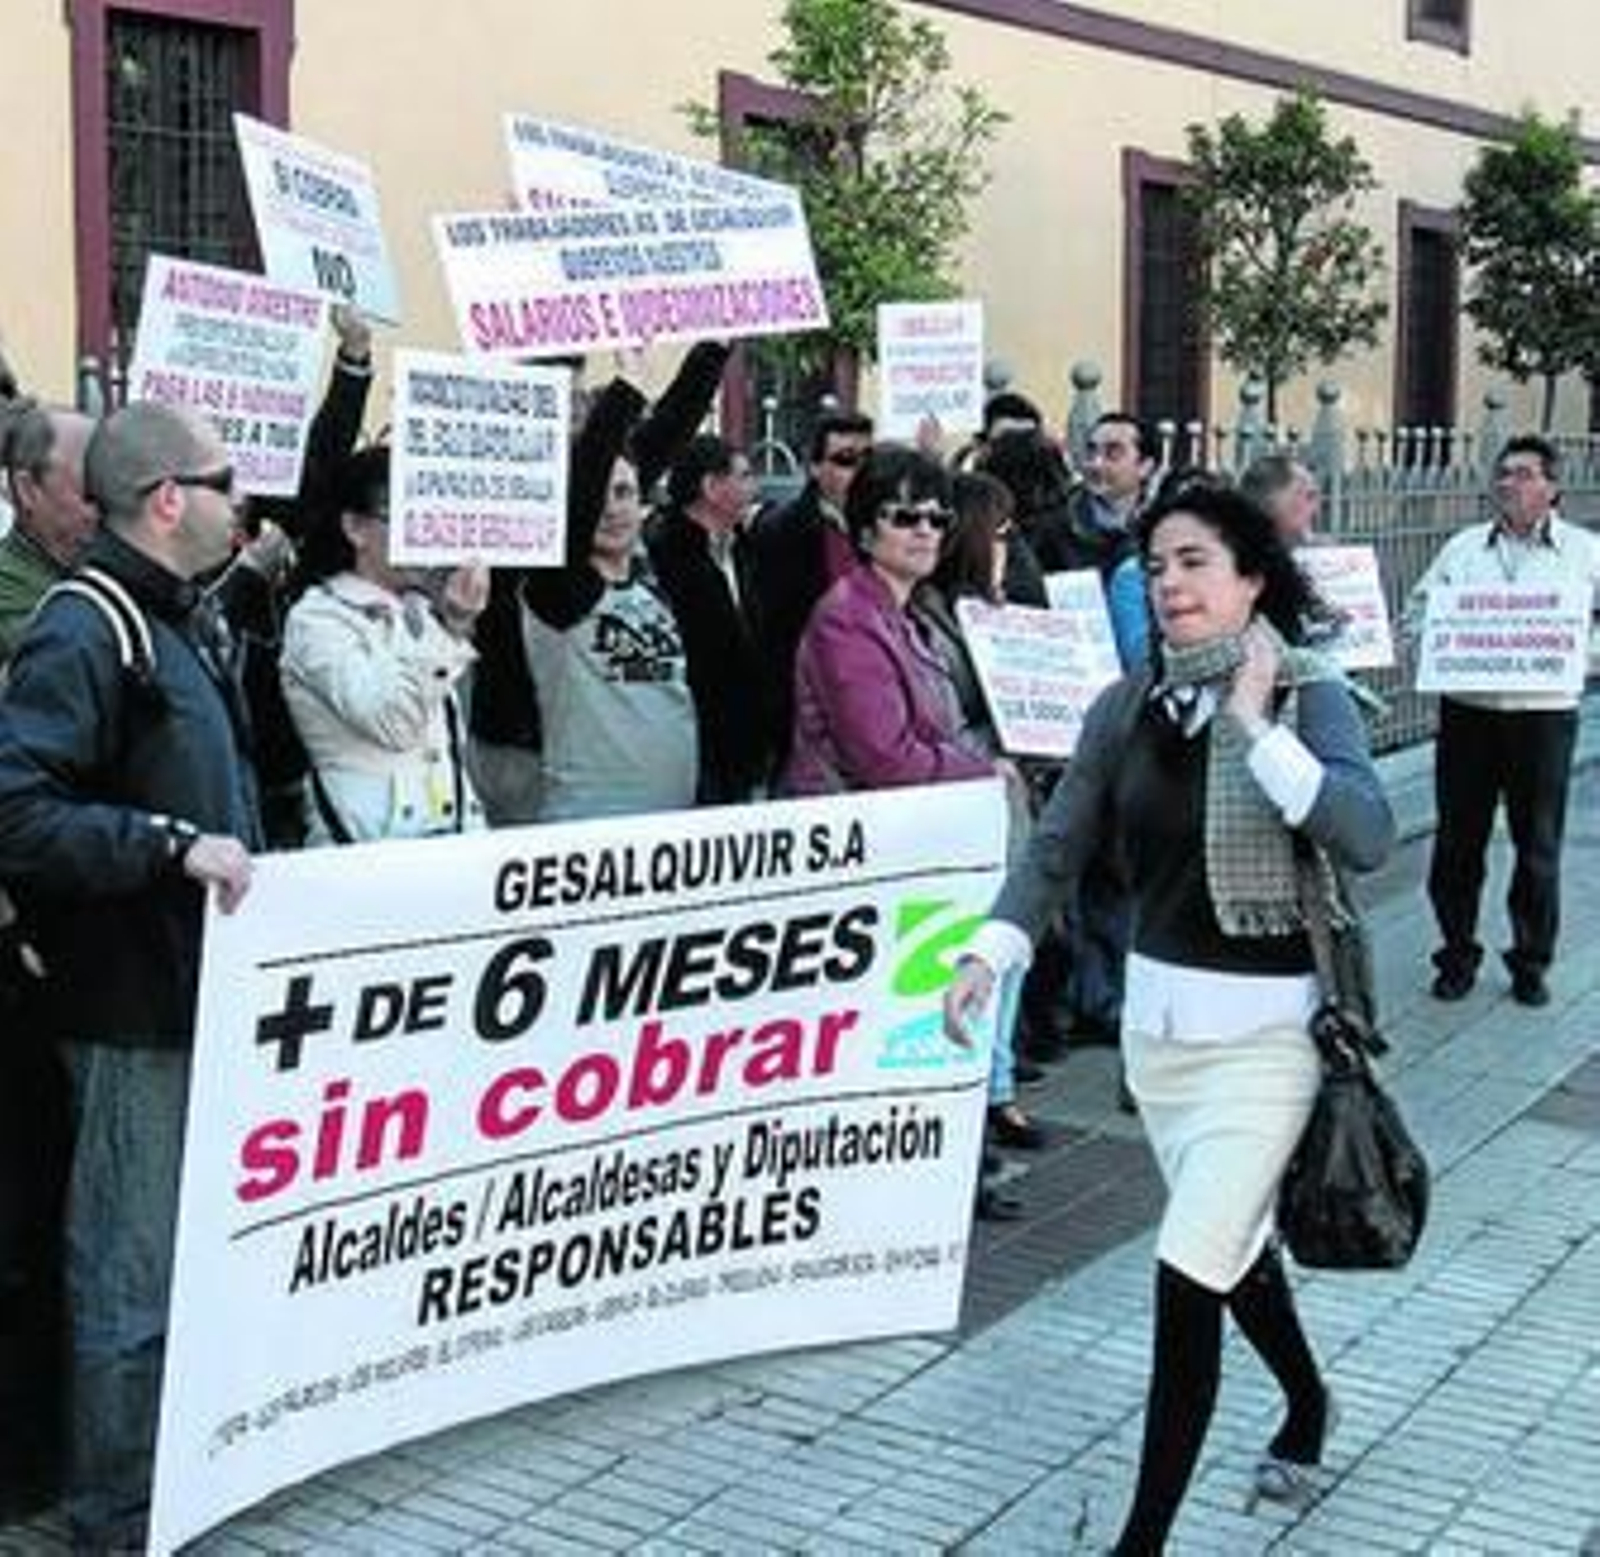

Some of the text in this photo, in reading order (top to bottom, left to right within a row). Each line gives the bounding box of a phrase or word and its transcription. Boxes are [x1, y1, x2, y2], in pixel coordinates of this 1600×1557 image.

[446, 220, 487, 248] LOS
[469, 292, 599, 353] SALARIOS
[600, 292, 620, 339] E
[494, 818, 866, 913] GESALQUIVIR S.A
[351, 973, 454, 1043] DE
[472, 934, 556, 1044] 6
[575, 904, 879, 1028] MESES
[235, 1008, 860, 1203] sin cobrar
[288, 1195, 468, 1296] Alcaldes
[495, 1147, 702, 1235] Alcaldesas
[707, 1140, 735, 1200] y
[742, 1103, 944, 1188] Diputación
[416, 1185, 822, 1328] RESPONSABLES
